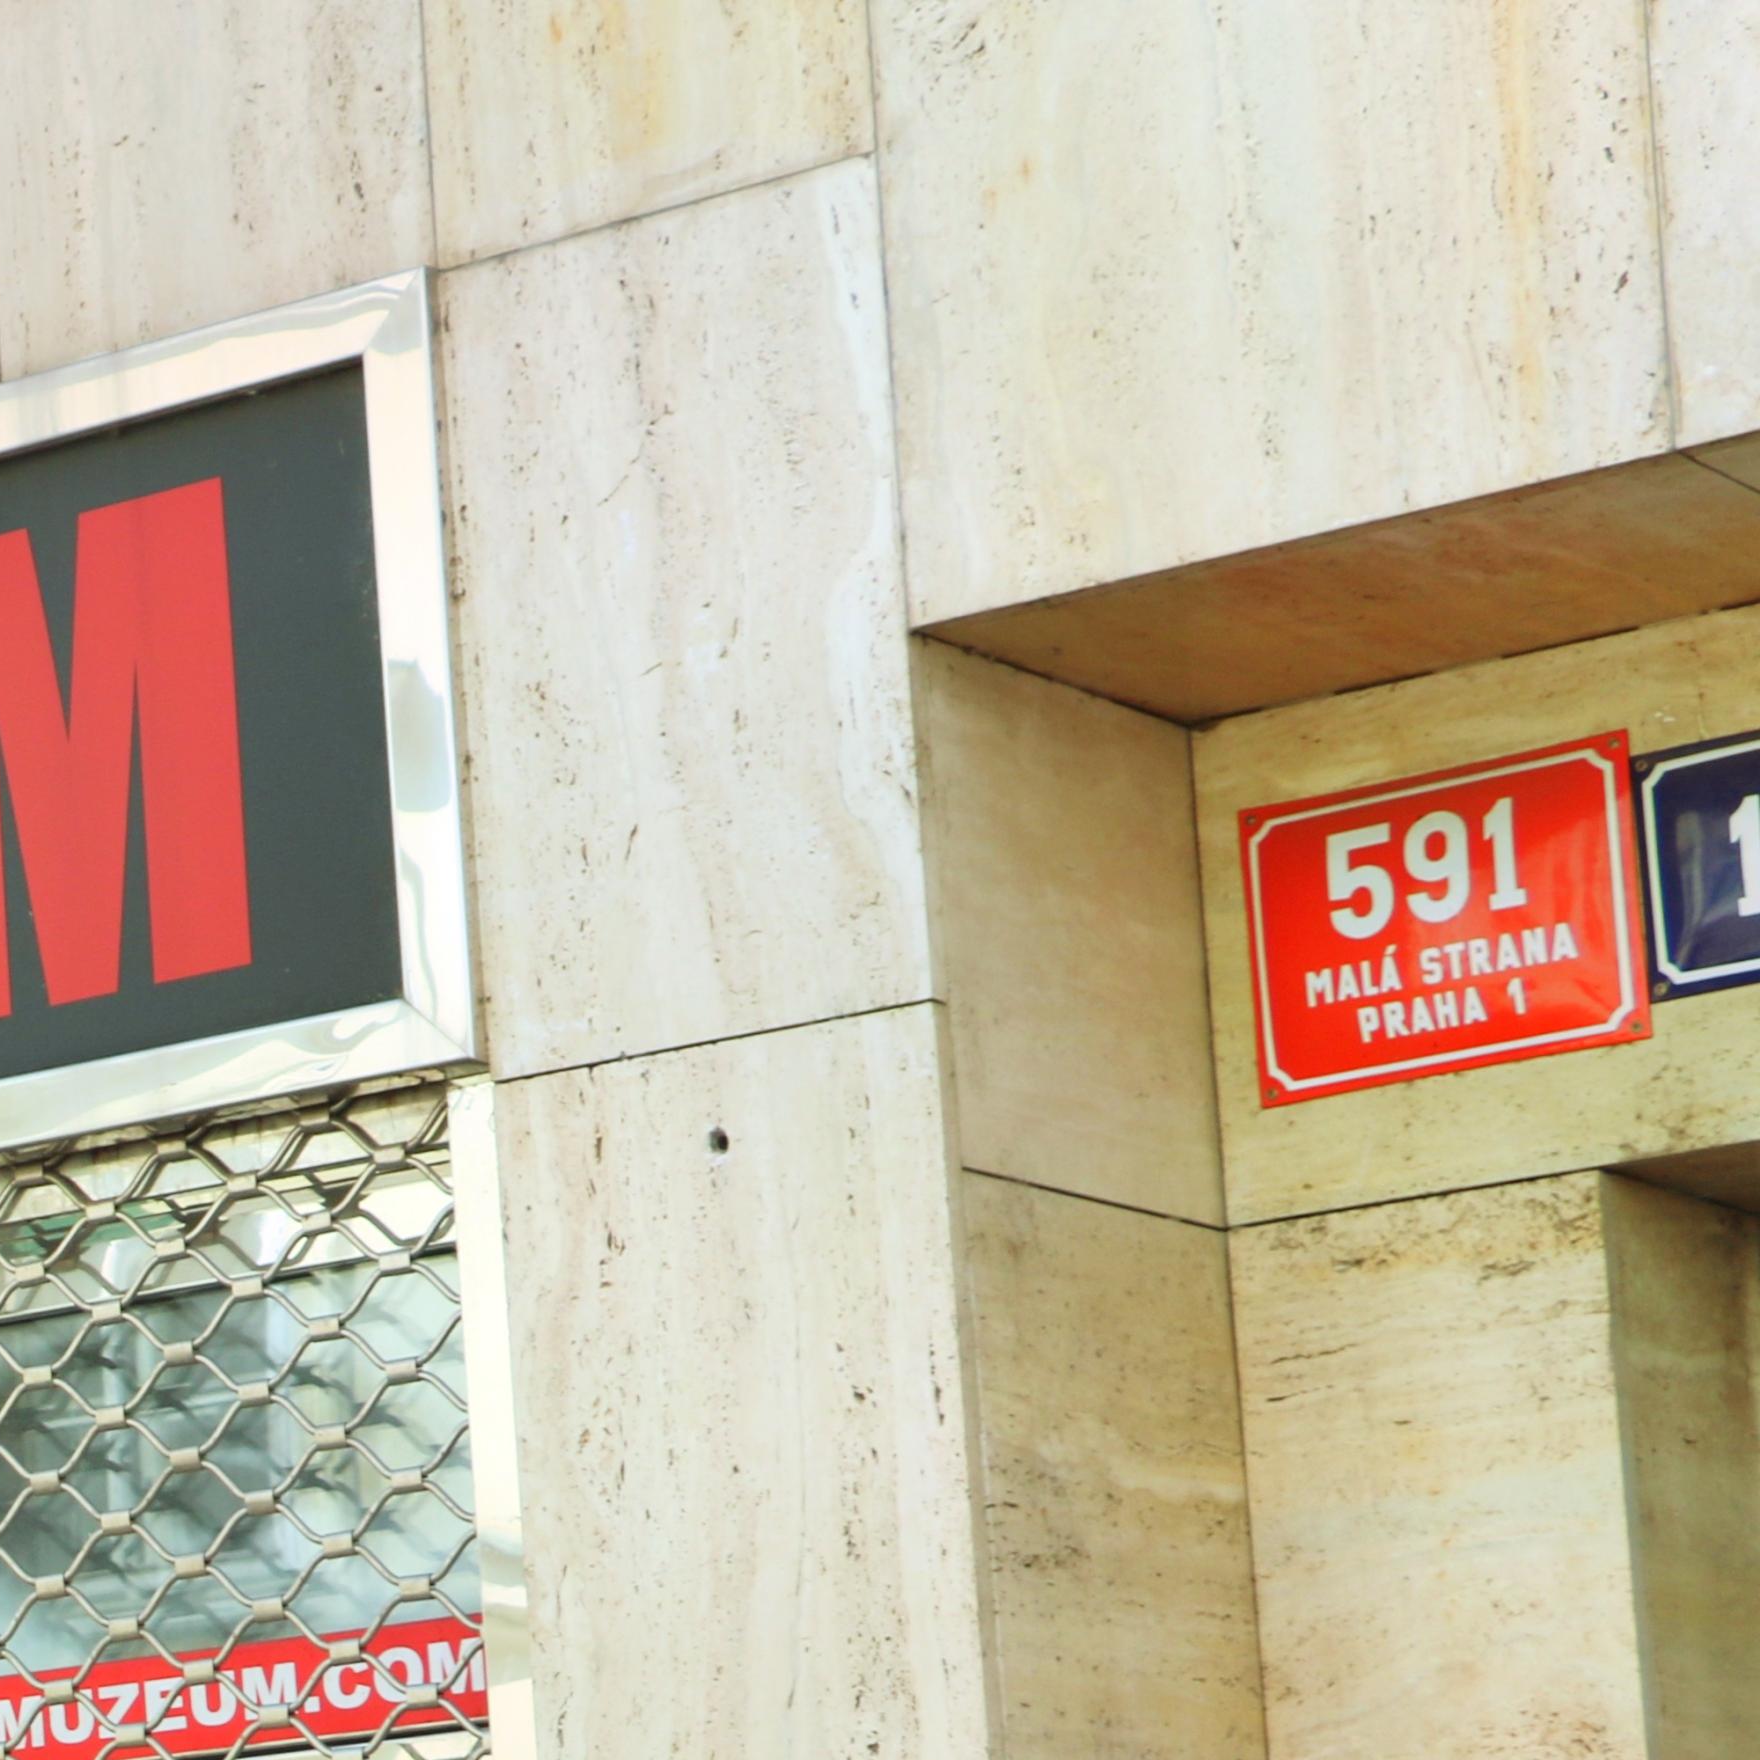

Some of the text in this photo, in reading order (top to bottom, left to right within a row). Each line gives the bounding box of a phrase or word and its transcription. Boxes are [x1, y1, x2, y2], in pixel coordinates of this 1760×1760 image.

[1326, 797, 1527, 939] 591
[1305, 922, 1579, 1008] MALÁ STRANA
[1357, 977, 1527, 1043] PRAHA 1
